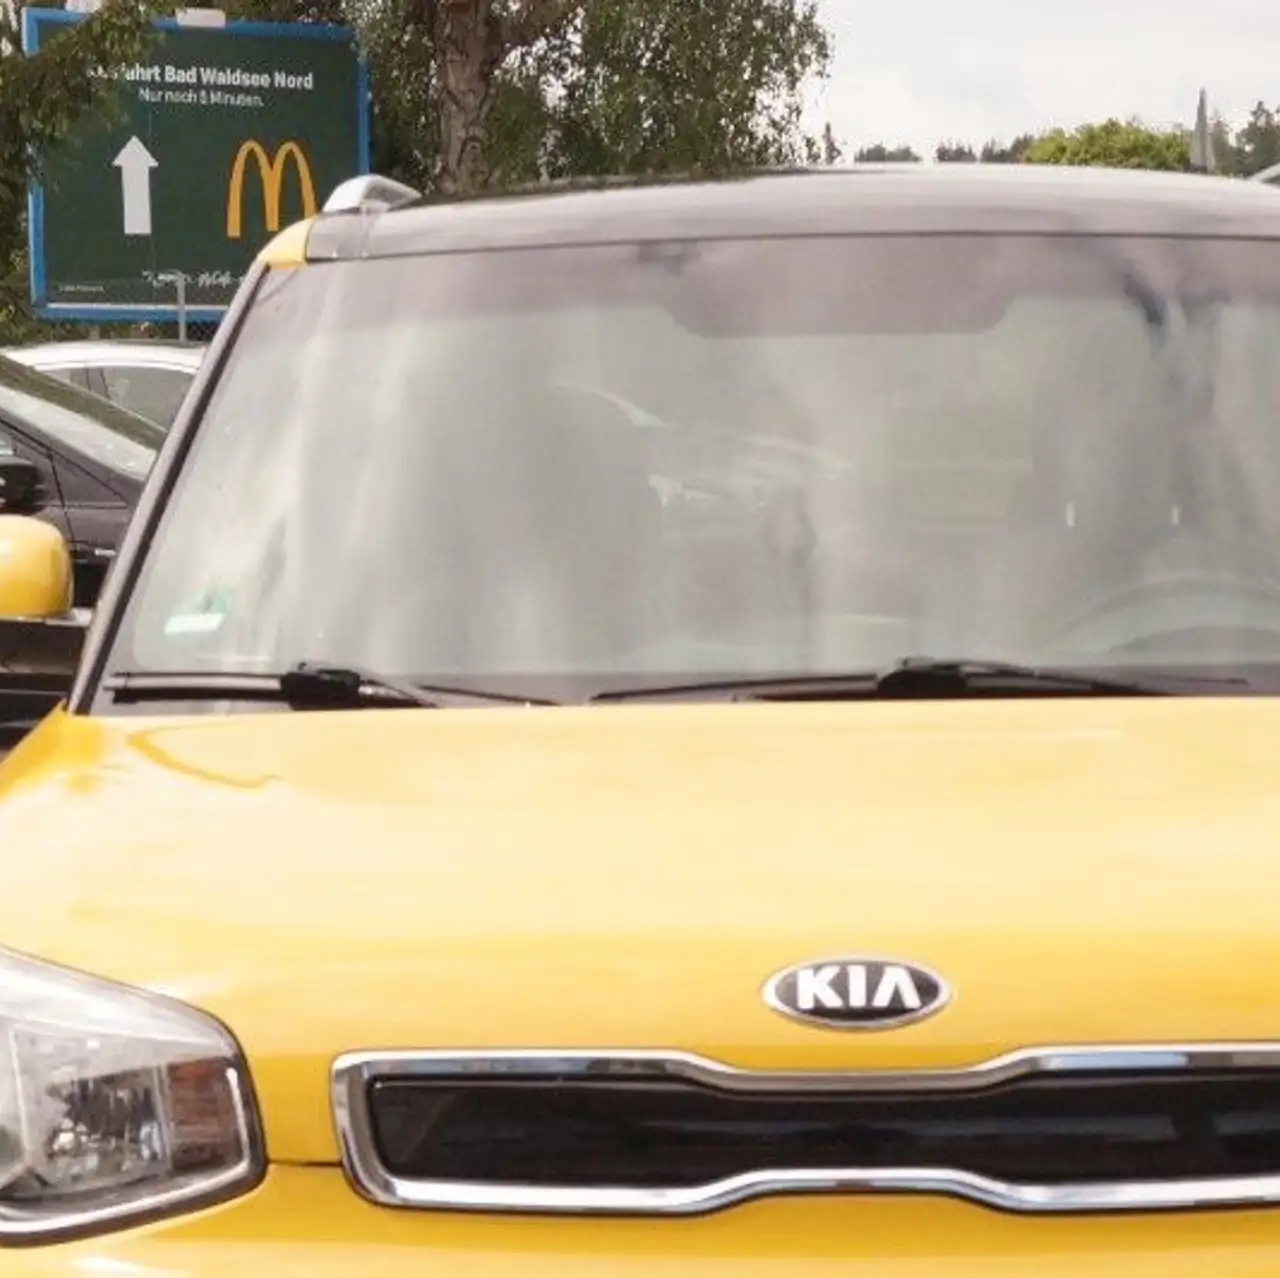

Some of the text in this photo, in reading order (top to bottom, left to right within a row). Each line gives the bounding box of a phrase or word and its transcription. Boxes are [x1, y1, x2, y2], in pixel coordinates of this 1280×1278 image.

[164, 65, 197, 84] Bad
[199, 67, 271, 88] Waldsee
[274, 71, 315, 90] Nord
[796, 964, 922, 1010] KIA
